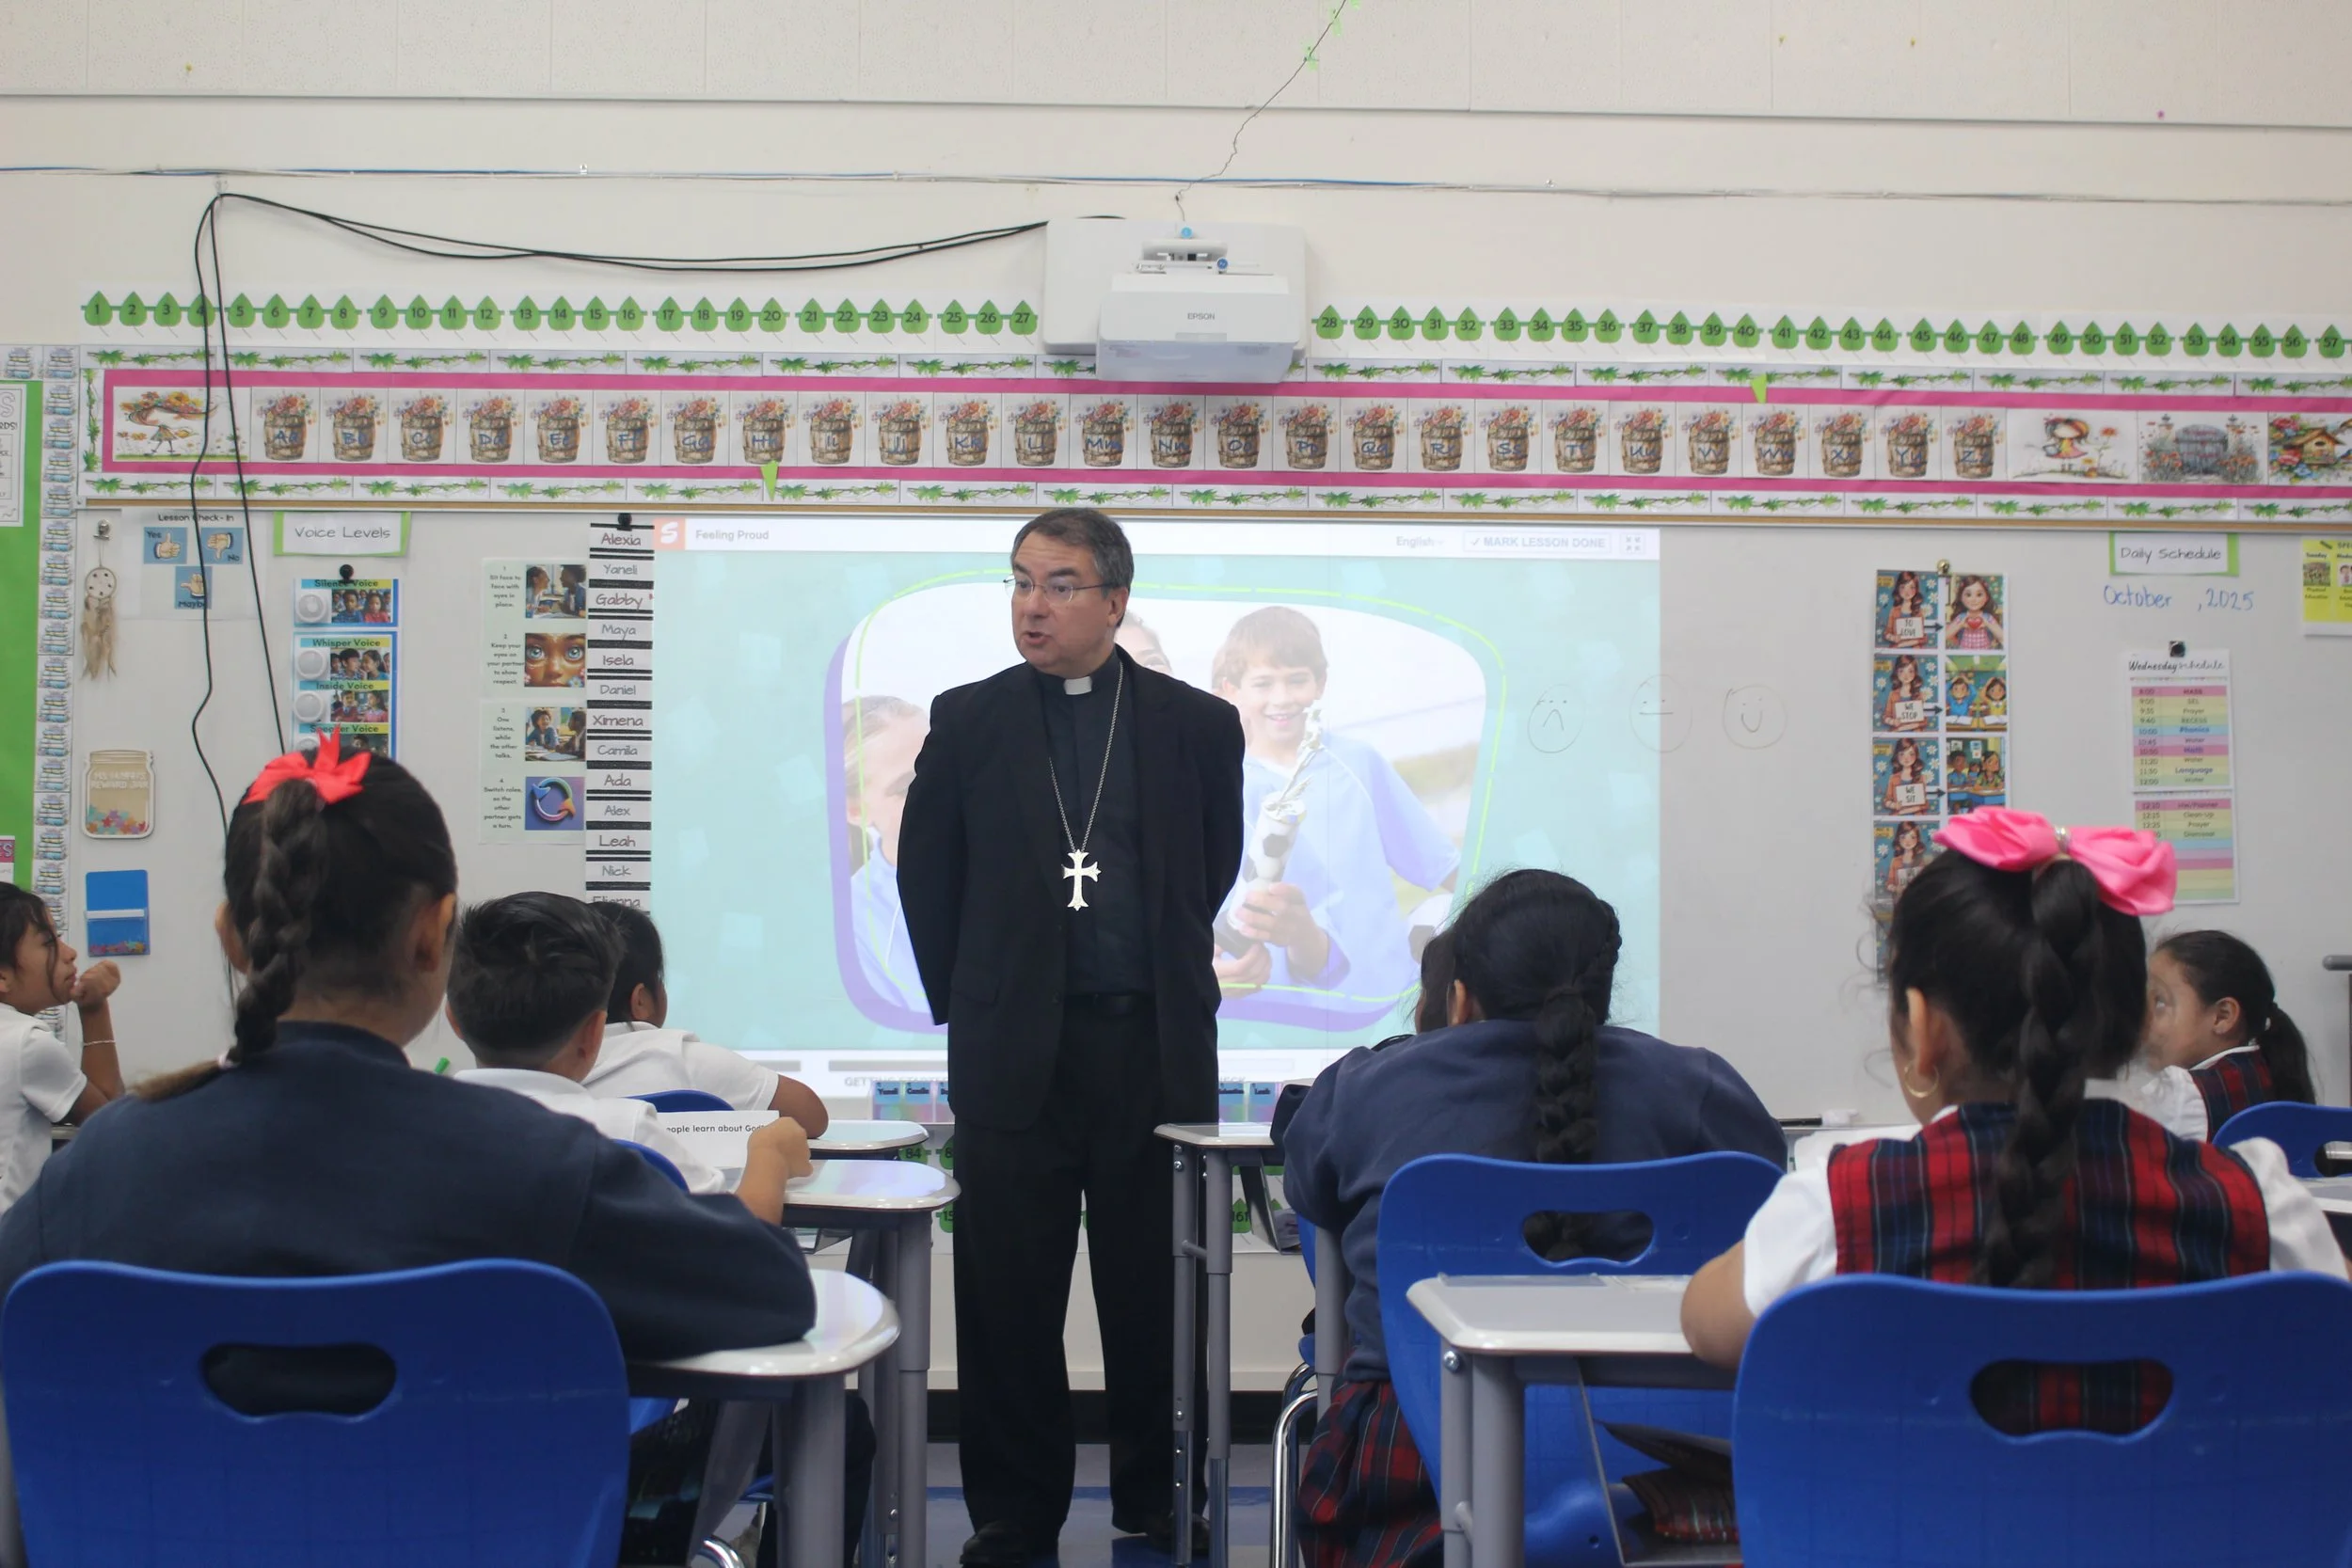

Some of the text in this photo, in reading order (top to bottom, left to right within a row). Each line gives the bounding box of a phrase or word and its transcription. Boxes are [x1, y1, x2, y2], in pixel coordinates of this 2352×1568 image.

[94, 303, 100, 315] 1
[128, 304, 136, 316] 2
[163, 303, 171, 316] 3
[236, 305, 245, 317] 5
[271, 306, 280, 318] 6
[307, 306, 315, 319] 7
[339, 308, 347, 320] 8
[378, 307, 389, 319] 9
[411, 307, 426, 319] 10
[447, 308, 457, 319] 11
[480, 308, 493, 321] 12
[519, 308, 532, 320] 13
[554, 308, 567, 319] 14
[589, 308, 602, 321] 15
[622, 309, 636, 321] 16
[662, 309, 675, 321] 17
[697, 309, 710, 321] 18
[730, 309, 744, 322] 19
[763, 309, 782, 322] 20
[804, 310, 818, 323] 21
[836, 310, 853, 323] 22
[872, 310, 889, 323] 23
[905, 311, 921, 323] 24
[946, 311, 962, 324] 25
[979, 311, 997, 324] 26
[1015, 311, 1030, 325] 27
[1186, 312, 1216, 321] EPSON
[1322, 316, 1338, 328] 28
[1358, 317, 1375, 329] 29
[1392, 317, 1410, 329] 30
[1429, 318, 1441, 330] 31
[1460, 319, 1476, 331] 32
[1500, 319, 1515, 331] 33
[1534, 320, 1549, 331] 34
[1567, 320, 1582, 332] 35
[1600, 320, 1616, 332] 36
[1638, 321, 1653, 333] 37
[1672, 323, 1687, 335] 38
[1706, 324, 1722, 337] 39
[1737, 325, 1756, 337] 40
[1778, 326, 1791, 339] 41
[1809, 328, 1826, 340] 42
[1844, 328, 1860, 341] 43
[1875, 329, 1892, 341] 44
[157, 514, 190, 523] Lesson
[147, 530, 162, 539] Yes
[294, 526, 391, 539] Voice Levels
[600, 531, 643, 546] Alexia
[695, 529, 771, 543] Feeling Proud
[1395, 535, 1436, 548] English
[1483, 535, 1605, 548] MARK LESSON DONE
[227, 554, 240, 562] No
[2120, 546, 2222, 566] Daily Schedule
[603, 563, 639, 576] Yaneli
[356, 579, 379, 588] Voice
[595, 593, 644, 611] Gabby
[2103, 583, 2172, 610] October
[178, 601, 207, 610] Mayb
[601, 623, 637, 641] Maya
[311, 639, 381, 649] Whisper Voice
[602, 654, 635, 667] Isela
[2128, 660, 2177, 674] Wednesday
[315, 681, 374, 690] Inside Voice
[599, 684, 637, 696] Daniel
[592, 714, 644, 728] Ximena
[352, 724, 379, 733] Voice
[597, 744, 639, 757] Camila
[2175, 766, 2214, 774] Language
[603, 773, 632, 787] Ada
[603, 804, 632, 817] Alex
[598, 835, 637, 848] Leah
[601, 864, 632, 877] Nick
[692, 1124, 716, 1133] learn
[717, 1124, 743, 1133] about
[904, 1148, 922, 1160] 84
